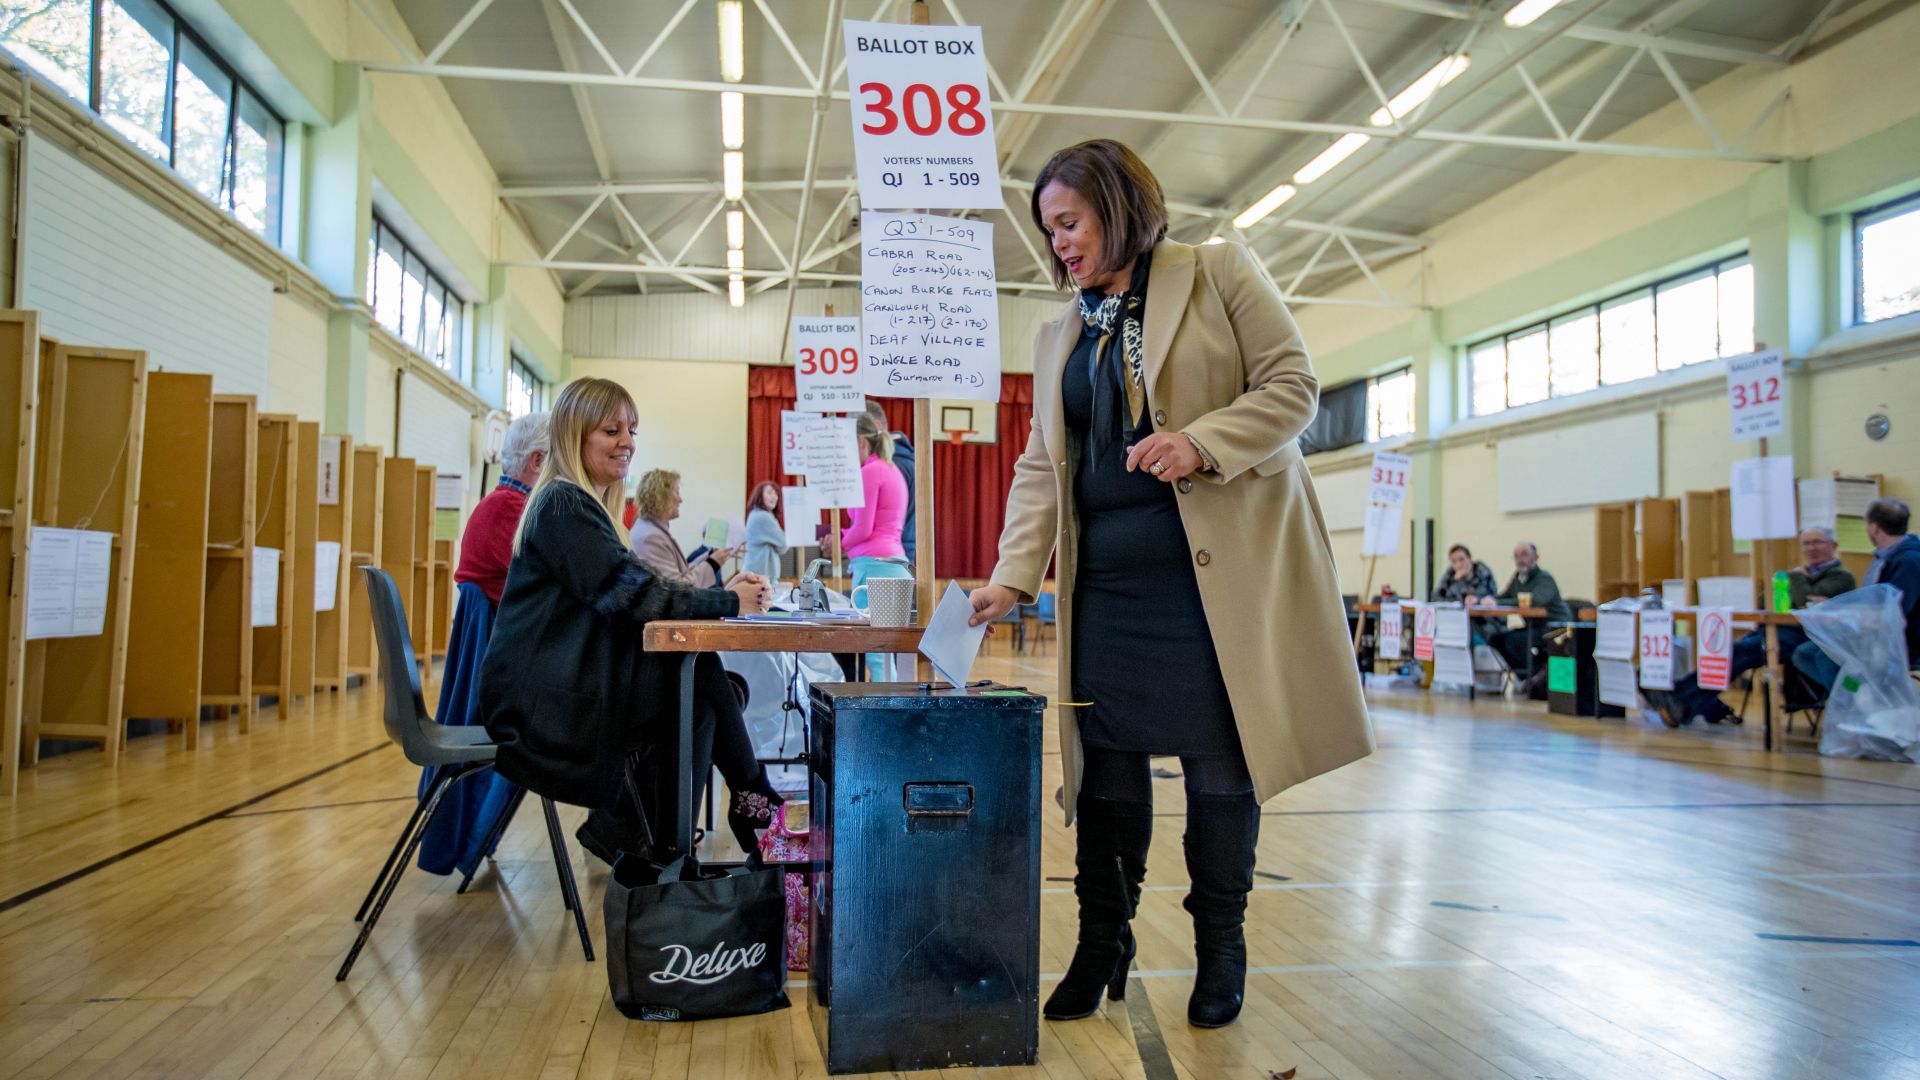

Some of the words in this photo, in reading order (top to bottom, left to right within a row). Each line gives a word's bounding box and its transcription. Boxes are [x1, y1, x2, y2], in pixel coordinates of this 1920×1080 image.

[857, 37, 928, 54] BALLOT
[935, 41, 975, 55] BOX
[859, 82, 986, 136] 308
[884, 157, 923, 165] VOTERS'
[926, 157, 974, 165] NUMBERS
[882, 172, 903, 188] QJ
[922, 173, 933, 186] 1
[950, 172, 980, 186] 509
[884, 219, 917, 236] QJ
[868, 248, 914, 259] CABRA
[864, 285, 903, 296] CANON
[962, 286, 993, 297] FLATS
[865, 303, 928, 313] CARNLOUGH
[939, 302, 972, 313] ROAD
[799, 324, 833, 333] BALLOT
[836, 324, 856, 333] BOX
[870, 334, 909, 345] DEAF
[799, 347, 859, 375] 309
[925, 355, 961, 367] ROAD
[1731, 376, 1781, 410] 312
[1372, 467, 1405, 488] 311
[1643, 635, 1670, 657] 312
[649, 941, 767, 984] Deluxe
